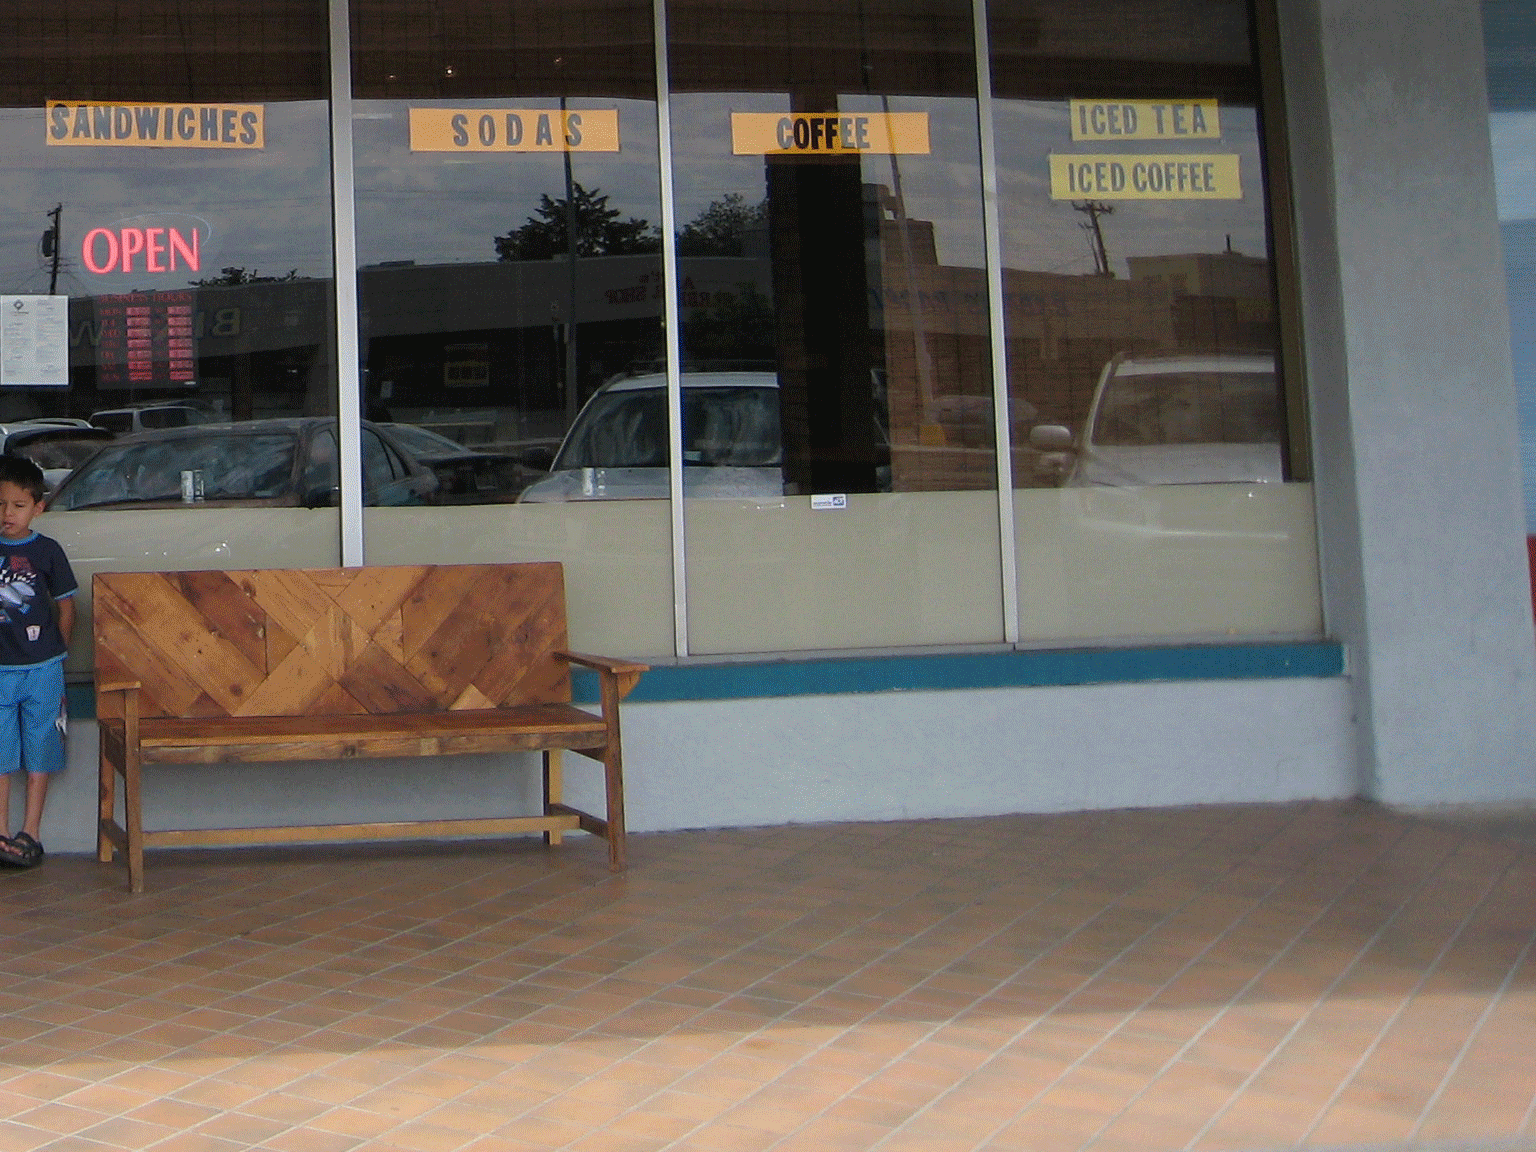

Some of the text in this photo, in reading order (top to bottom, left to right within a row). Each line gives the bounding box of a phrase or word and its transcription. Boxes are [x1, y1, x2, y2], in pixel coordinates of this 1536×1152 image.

[50, 104, 258, 144] SANDWICHES
[451, 113, 583, 147] SODAS
[776, 117, 871, 150] COFFEE
[1078, 103, 1208, 136] ICED TEA
[1068, 163, 1216, 193] ICED COFFEE
[82, 227, 201, 275] OPEN
